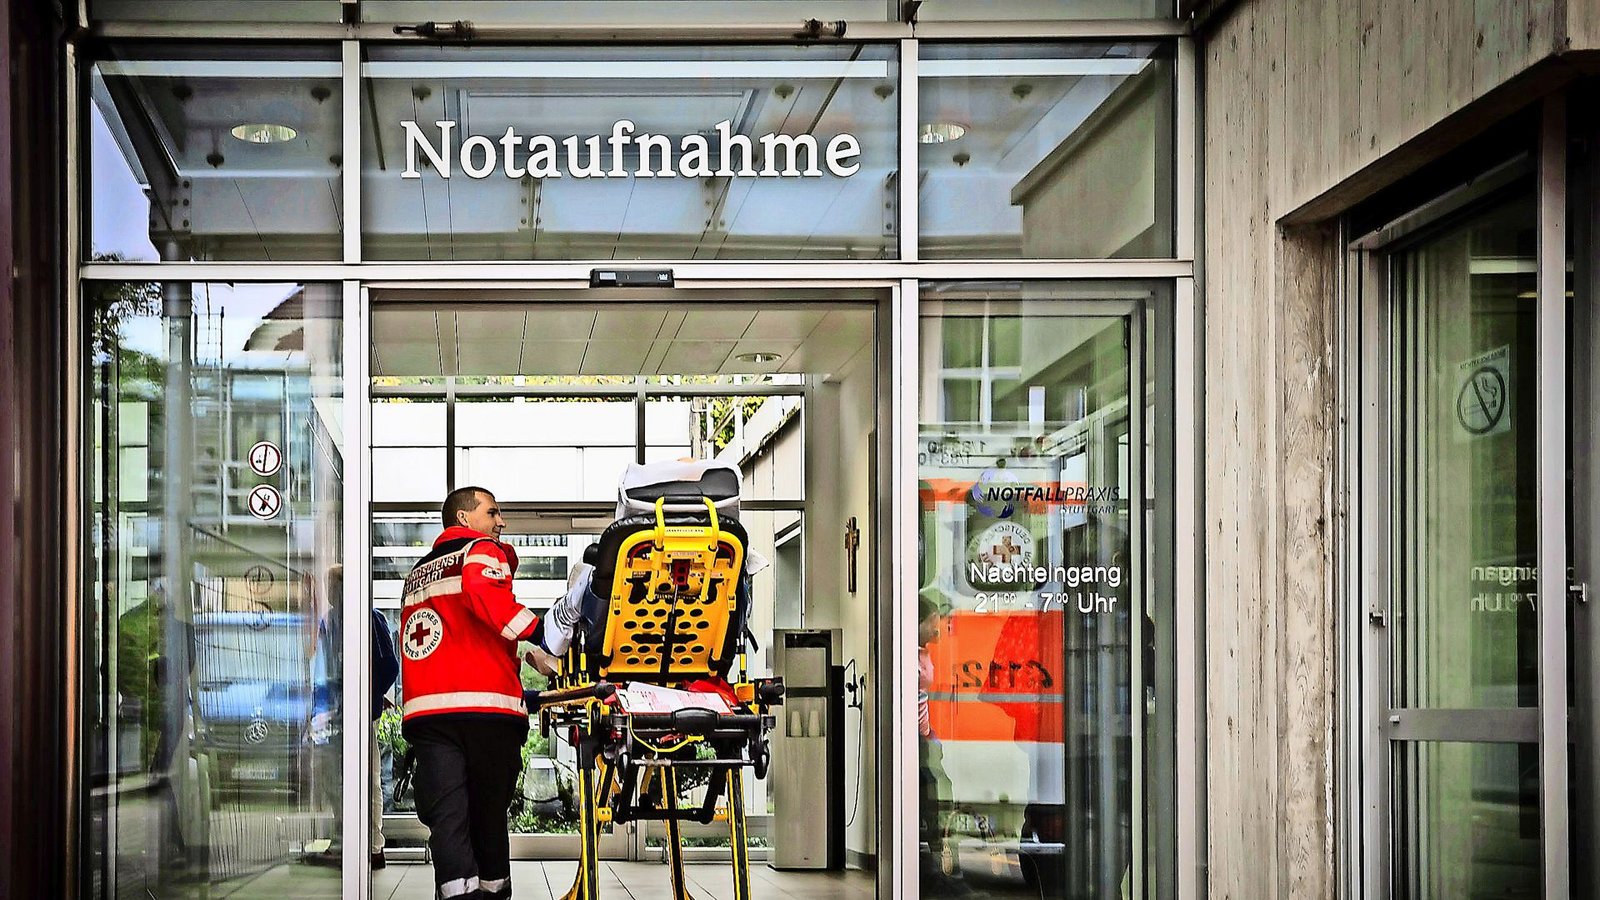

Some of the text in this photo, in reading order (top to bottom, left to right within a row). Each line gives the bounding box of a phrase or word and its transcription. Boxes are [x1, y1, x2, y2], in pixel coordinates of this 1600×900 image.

[399, 119, 862, 179] Notaufnahme
[987, 487, 1120, 501] NOTFALLPRAXIS
[1062, 505, 1117, 514] STUTTGART
[970, 563, 1121, 588] Nachteingang
[1077, 593, 1117, 613] Uhr
